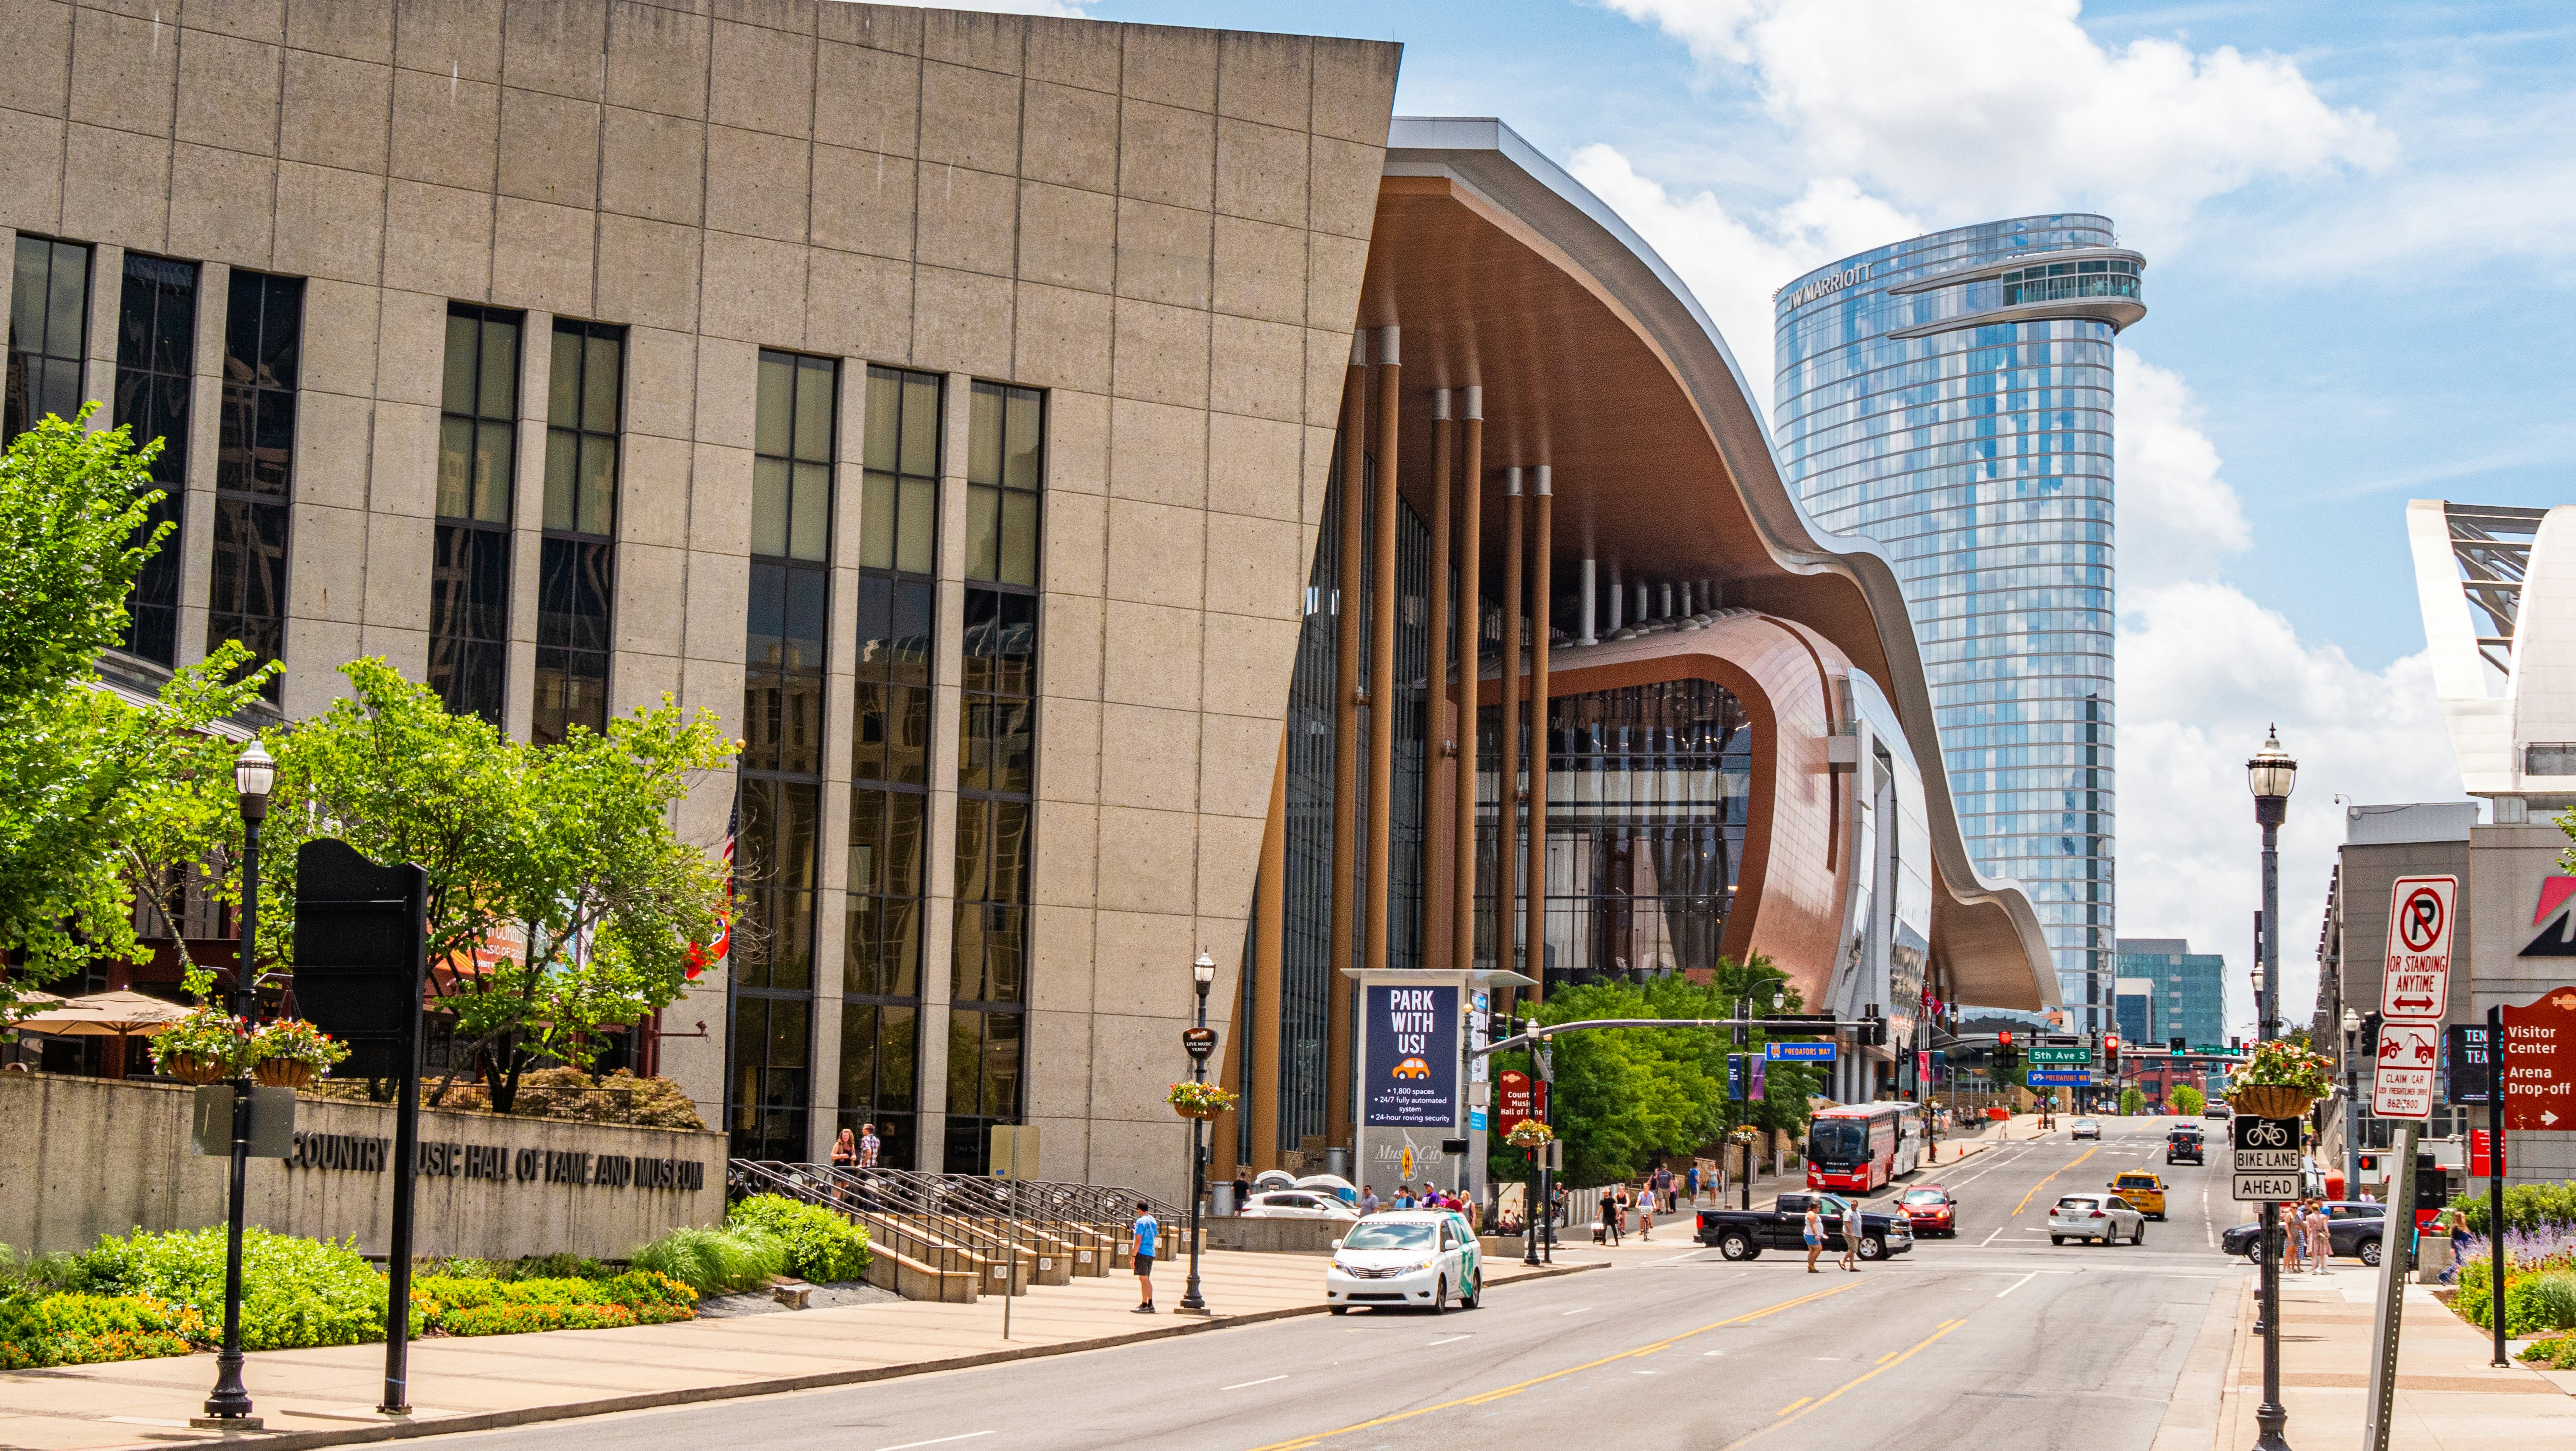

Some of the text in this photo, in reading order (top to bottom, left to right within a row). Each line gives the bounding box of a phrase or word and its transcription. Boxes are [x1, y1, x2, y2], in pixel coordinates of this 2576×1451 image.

[1787, 263, 1872, 311] JW MARRIOTT
[501, 947, 511, 956] OF
[2390, 956, 2446, 972] OR STANDING
[2396, 975, 2435, 992] ANYTIME
[1391, 990, 1434, 1010] PARK
[1391, 1012, 1434, 1032] WITH
[2465, 1030, 2488, 1042] TEN
[2508, 1026, 2556, 1038] Visitor
[1398, 1034, 1425, 1054] US!
[2508, 1043, 2557, 1054] Center
[2465, 1050, 2489, 1063] TEA
[2386, 1074, 2424, 1084] CLAIM CAR
[2509, 1066, 2552, 1078] Arena
[2509, 1083, 2571, 1097] Drop-off
[1396, 1096, 1410, 1105] fully
[290, 1131, 704, 1190] COUNTRY USIC HALL OF FAME AND MUSEUM
[1375, 1145, 1443, 1163] Mus City
[2237, 1153, 2297, 1166] BIKE LANE
[2242, 1180, 2292, 1194] AHEAD
